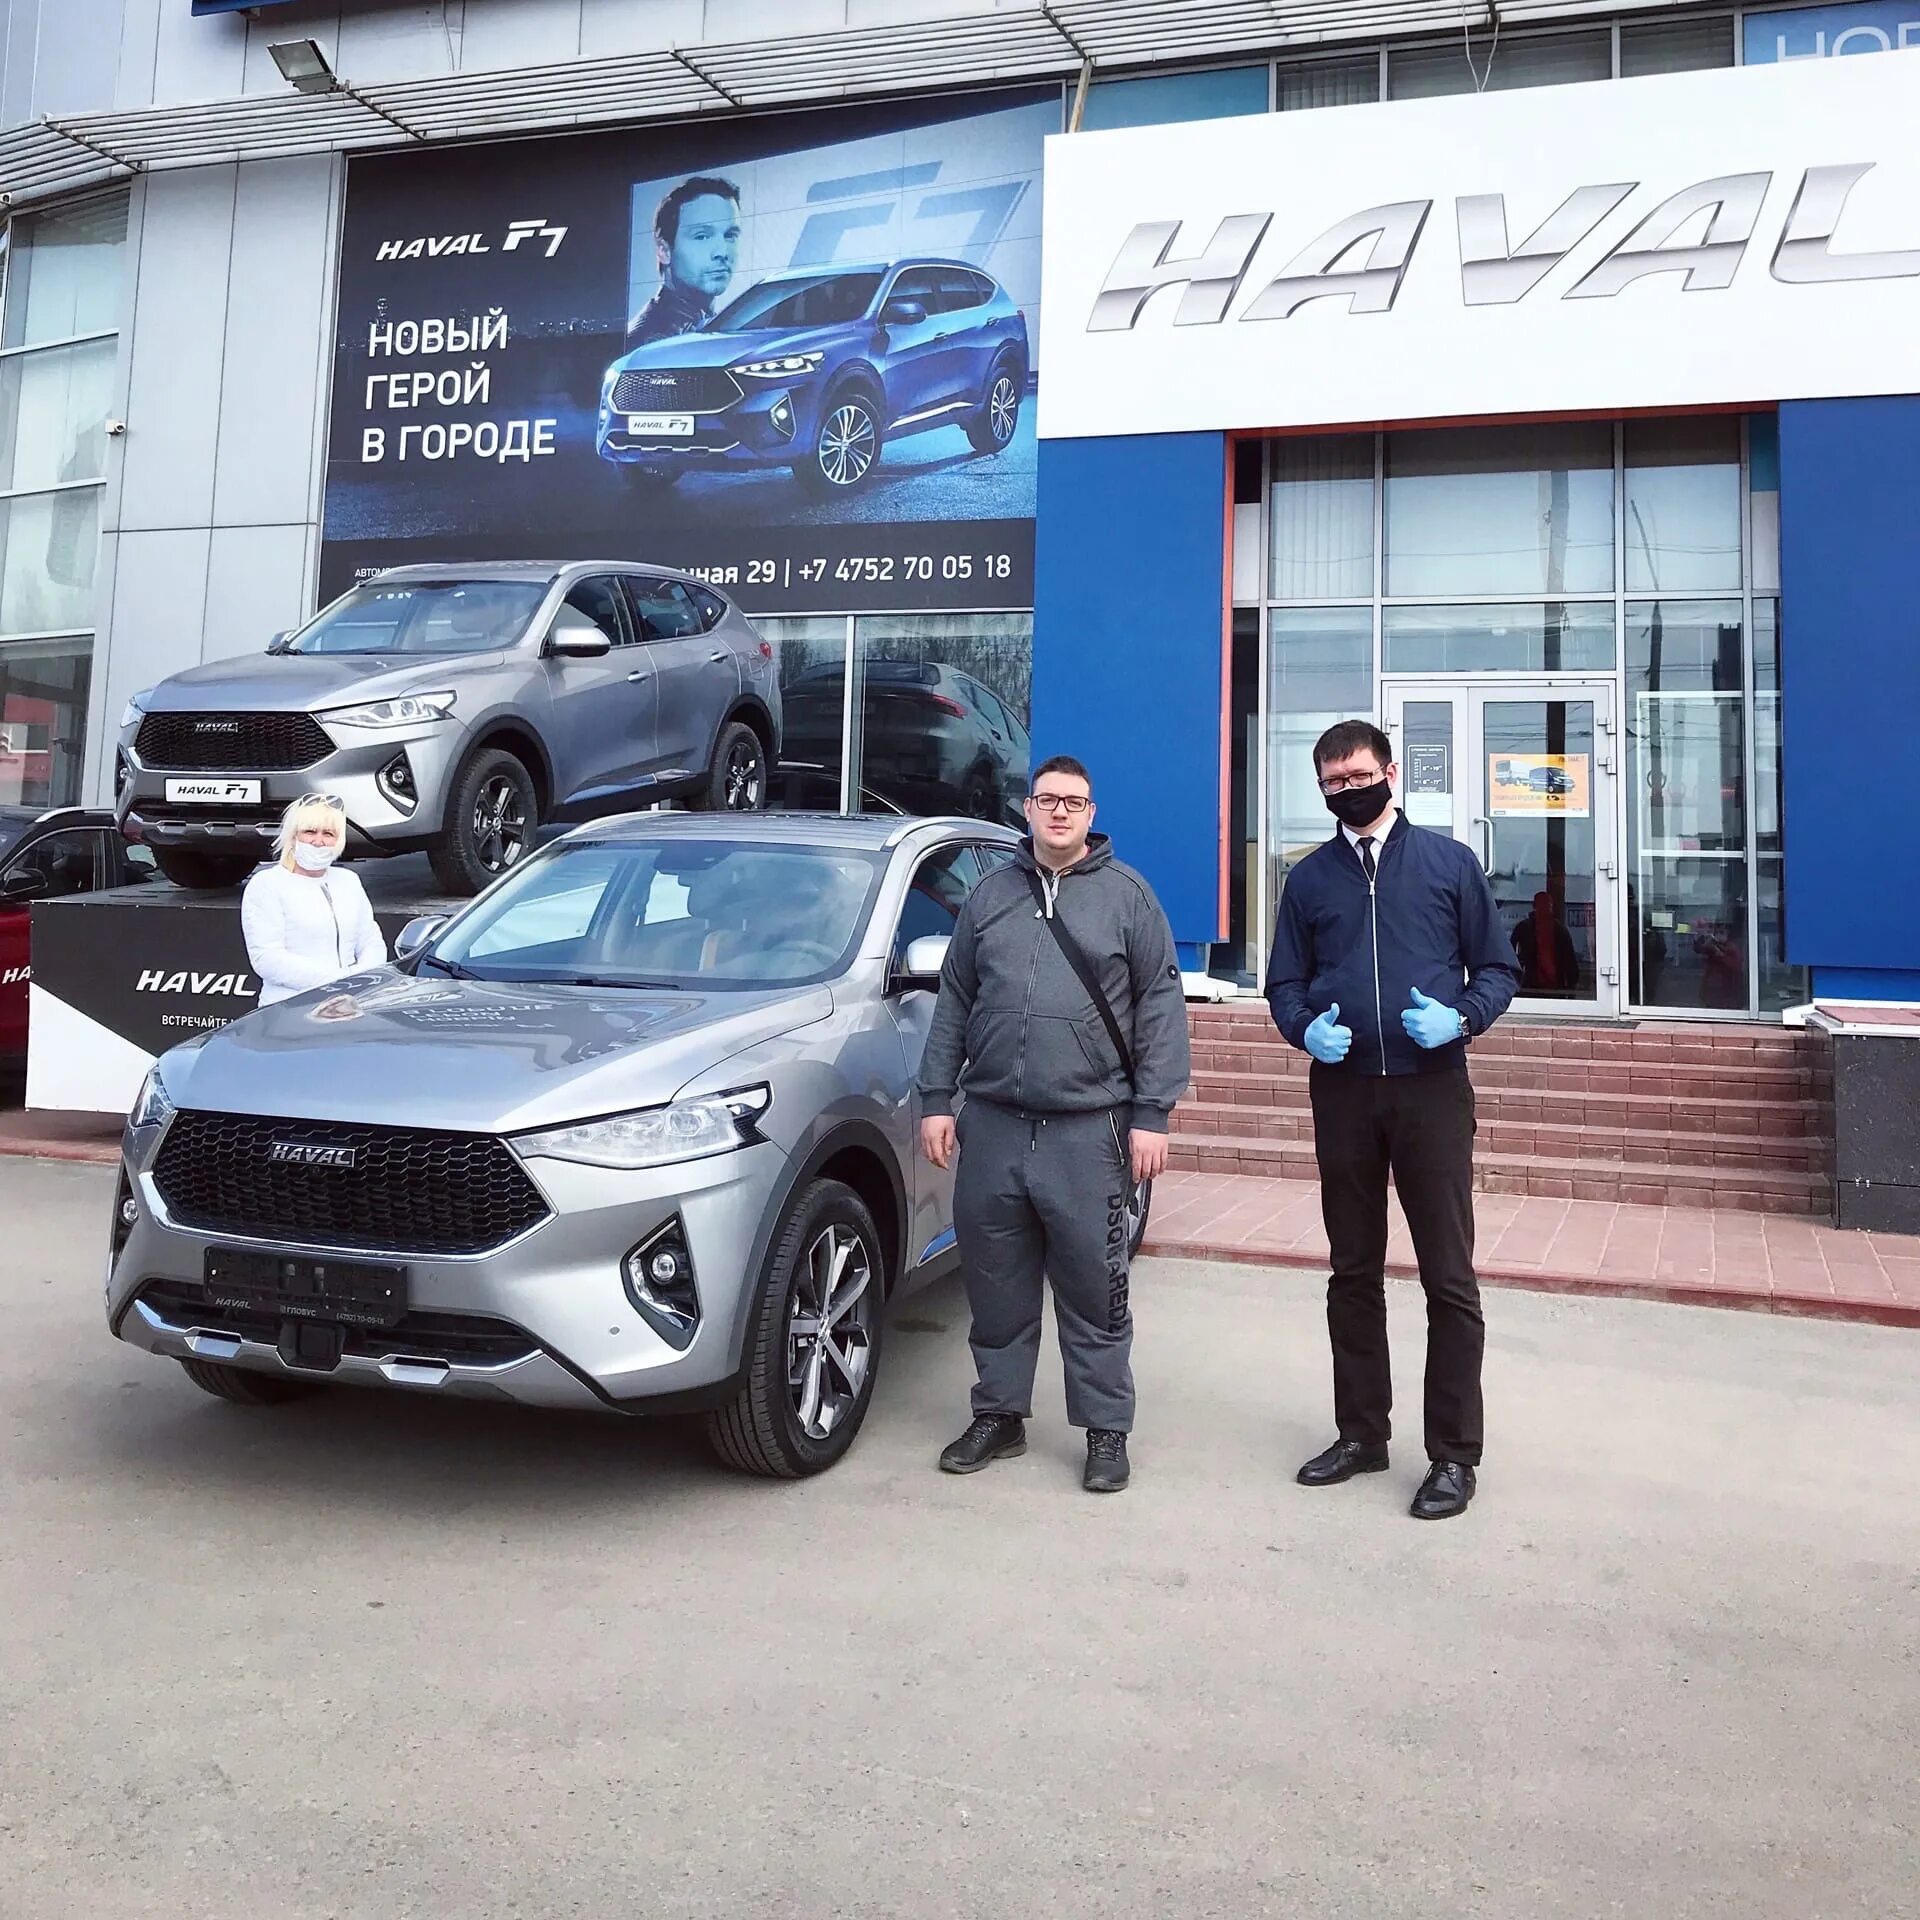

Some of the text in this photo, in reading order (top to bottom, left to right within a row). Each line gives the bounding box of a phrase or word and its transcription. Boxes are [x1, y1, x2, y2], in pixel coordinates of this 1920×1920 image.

[375, 219, 569, 261] HAVAL F7
[1086, 162, 1920, 333] HAVAL
[368, 307, 508, 357] НОВЫЙ
[365, 361, 491, 410] ГЕРОЙ
[633, 418, 689, 432] HAVAL F7
[361, 419, 557, 464] В ГОРОДЕ
[746, 560, 776, 584] 29
[798, 559, 827, 582] +7
[834, 557, 894, 582] 4752
[903, 556, 934, 581] 70
[942, 555, 973, 579] 05
[984, 554, 1011, 578] 18
[195, 723, 235, 732] HAVAL
[177, 784, 248, 799] HAVAL F7
[136, 969, 258, 997] HAVAL
[161, 1014, 228, 1029] ВСТРЕЧАЙТЕ
[272, 1144, 351, 1165] HAVAL
[215, 1297, 252, 1310] HAVAL
